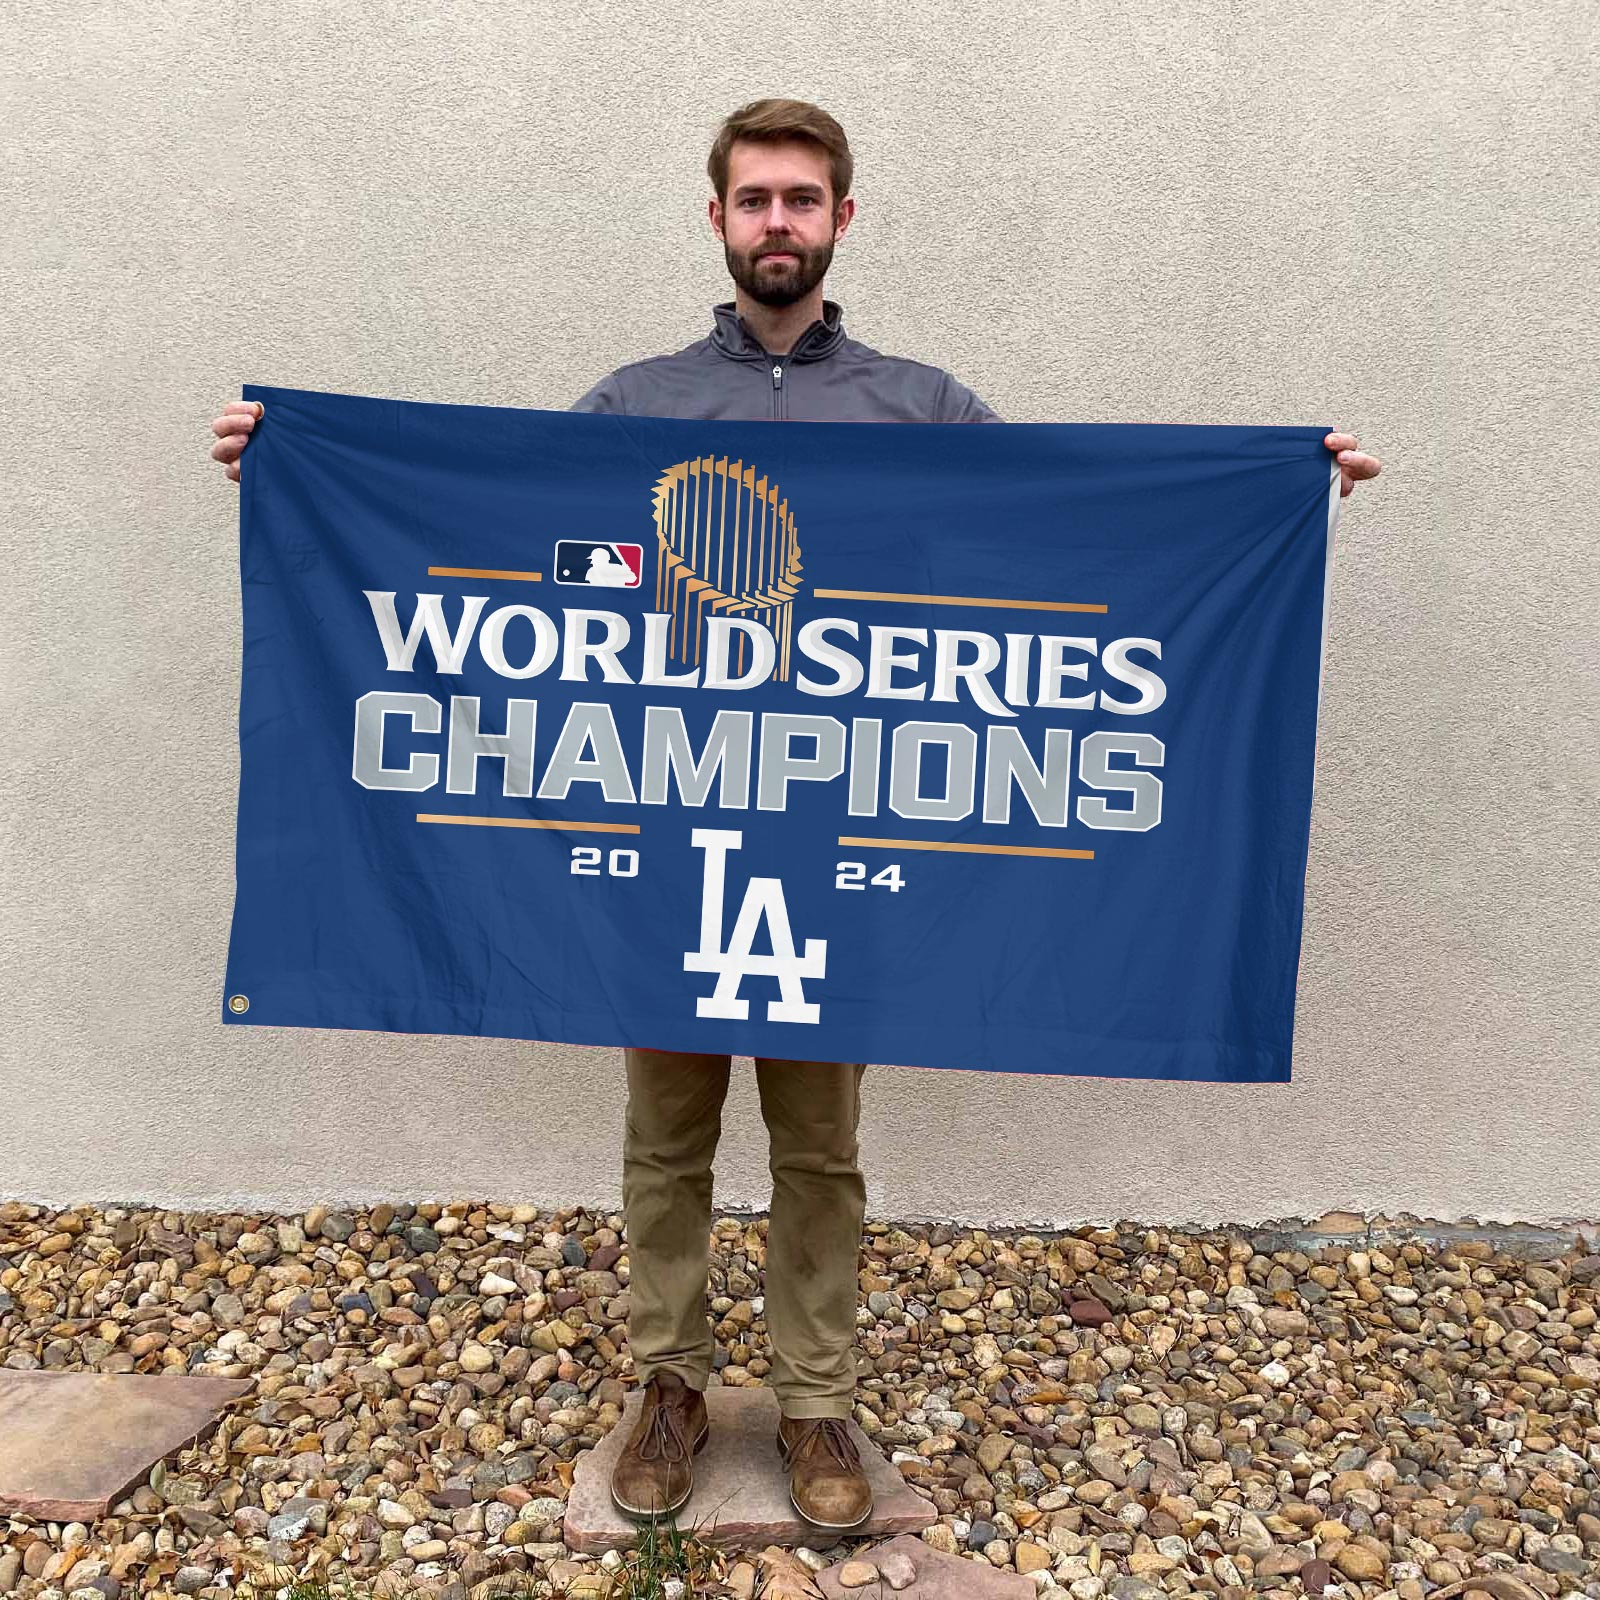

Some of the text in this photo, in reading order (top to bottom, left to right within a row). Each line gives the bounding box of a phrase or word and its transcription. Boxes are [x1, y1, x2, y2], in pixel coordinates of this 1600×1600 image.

[362, 590, 1167, 718] WORLD SERIES
[351, 690, 1166, 833] CHAMPIONS
[570, 846, 906, 893] 20 24
[683, 827, 828, 1025] LA
